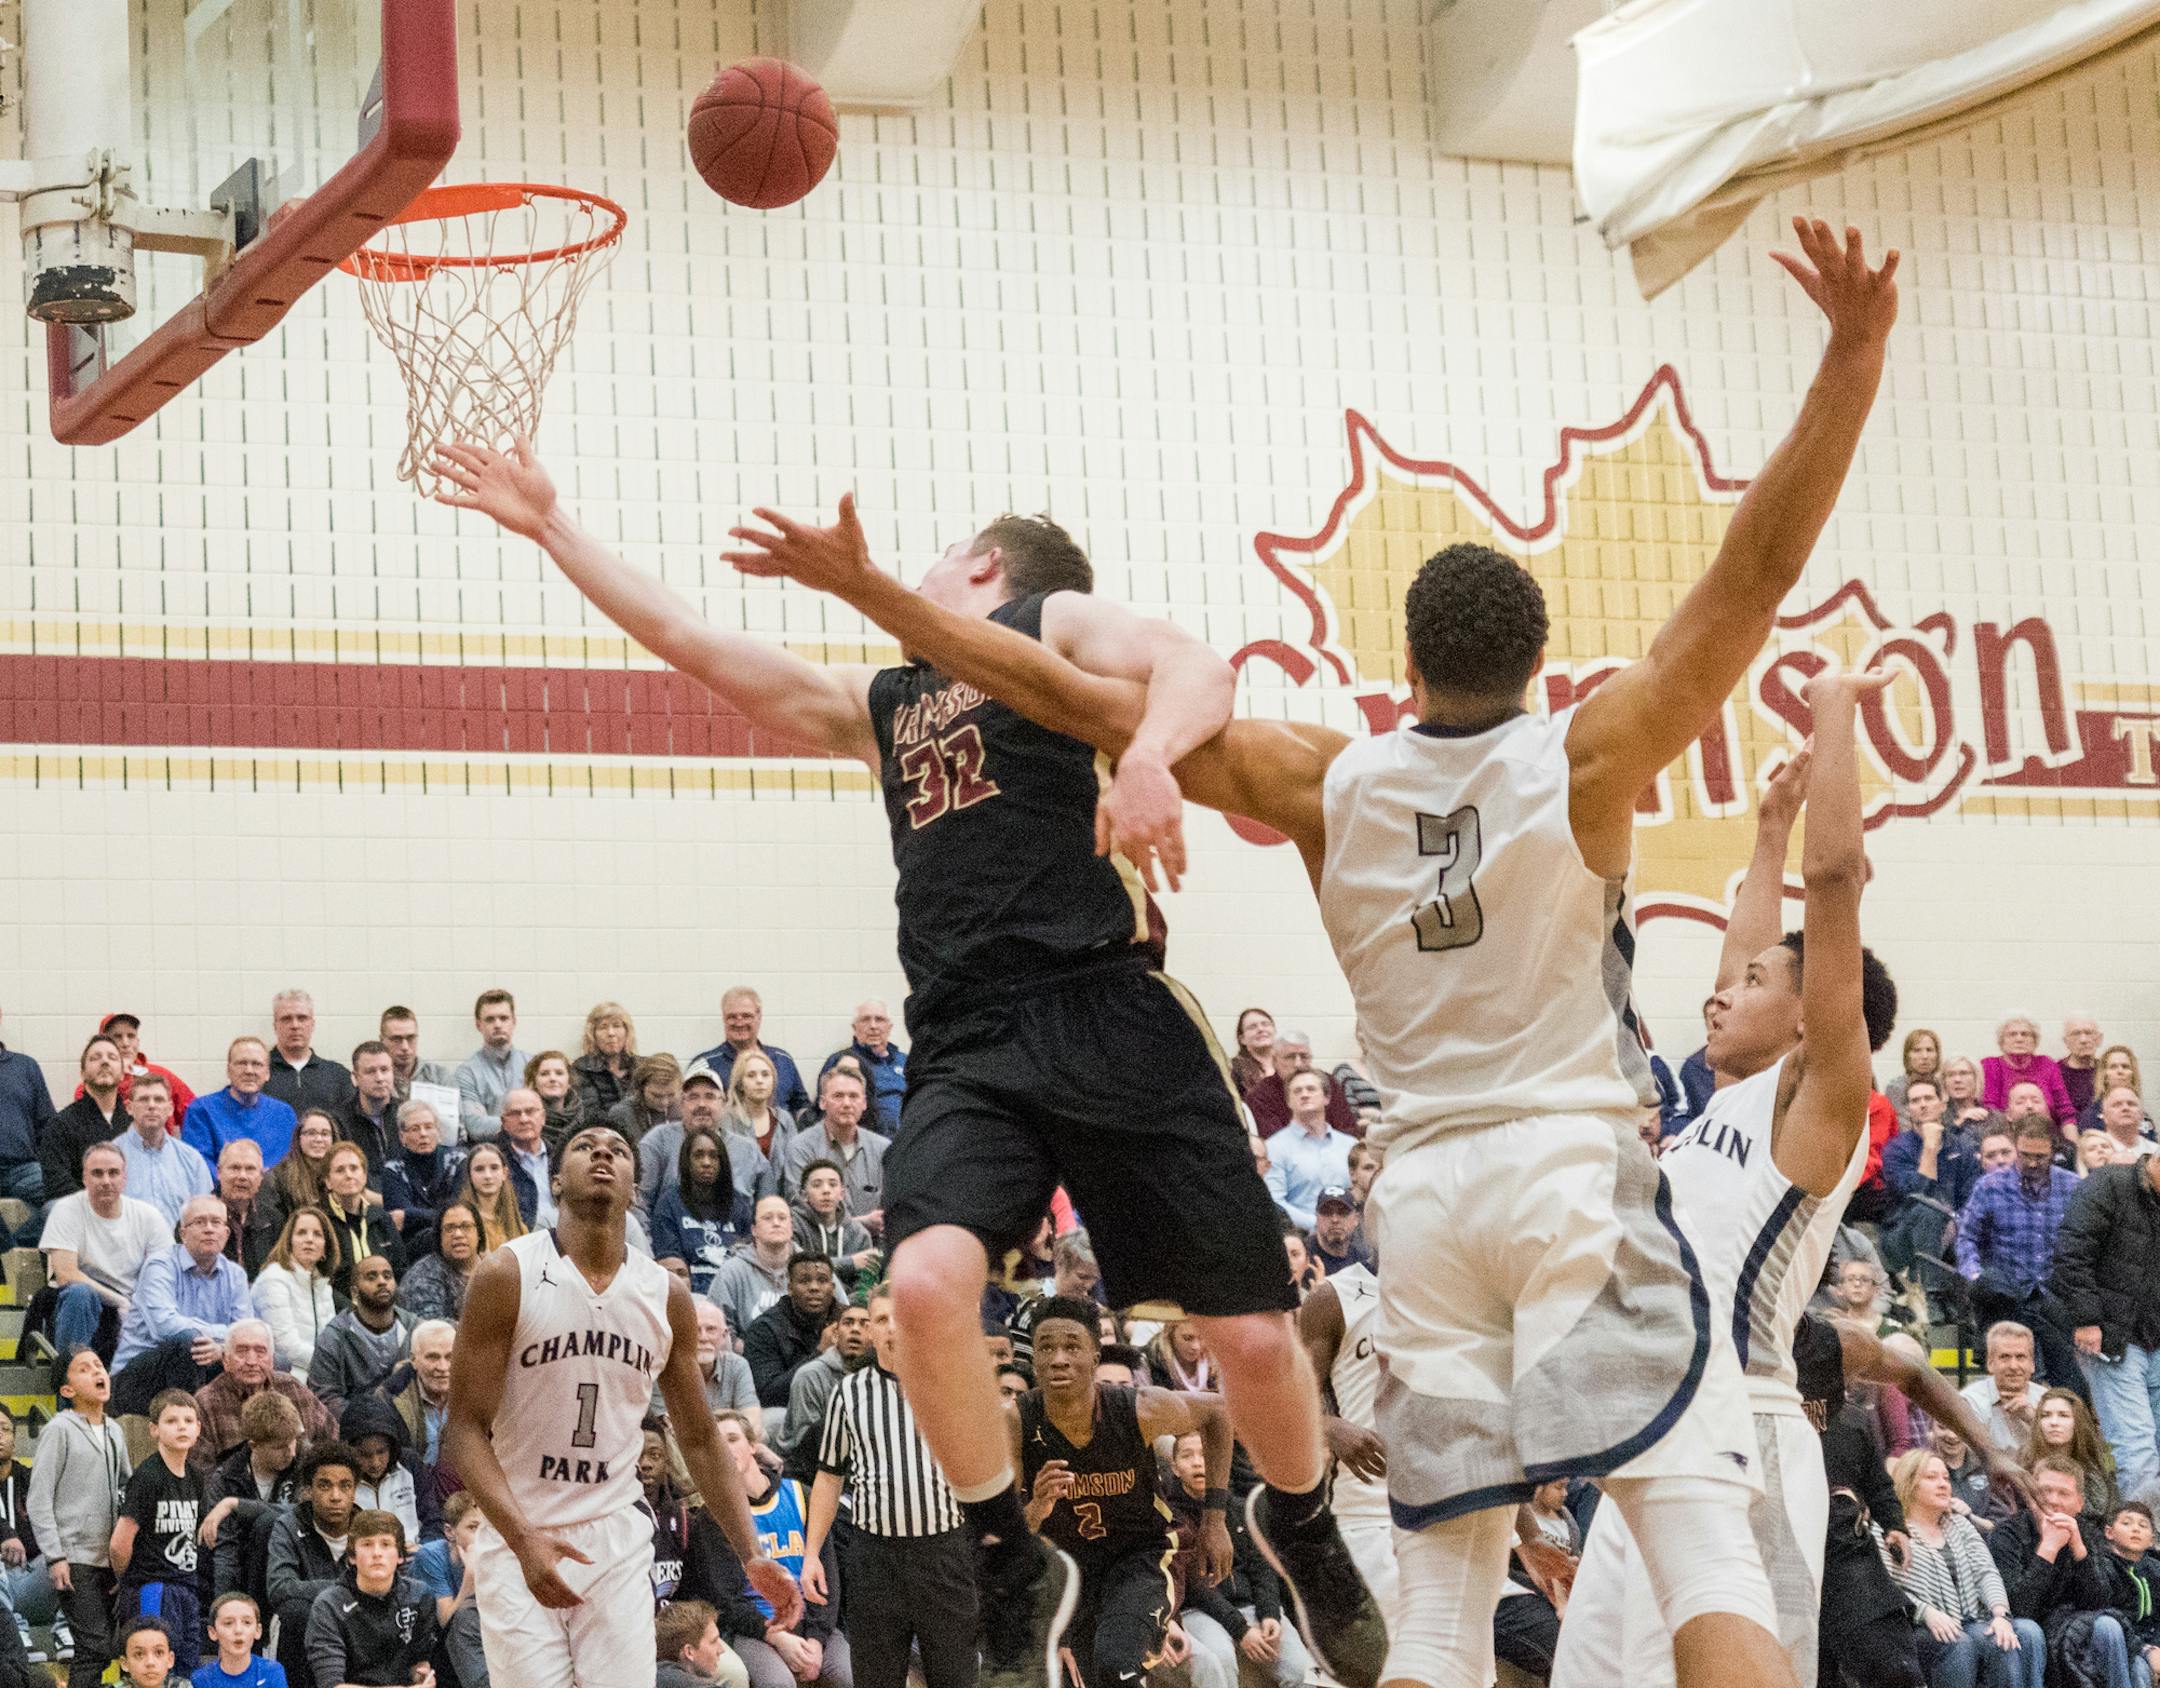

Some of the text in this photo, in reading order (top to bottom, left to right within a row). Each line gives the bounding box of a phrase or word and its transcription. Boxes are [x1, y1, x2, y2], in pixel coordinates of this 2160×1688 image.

[900, 723, 1002, 830] 32
[1410, 804, 1485, 952] 3
[1692, 1119, 1753, 1169] LIN
[520, 1330, 654, 1380] CHAMPLIN
[571, 1383, 600, 1449] 1
[539, 1454, 610, 1484] PARK
[1065, 1468, 1136, 1500] IMSON
[1073, 1502, 1107, 1541] 2
[655, 1560, 684, 1585] ERS
